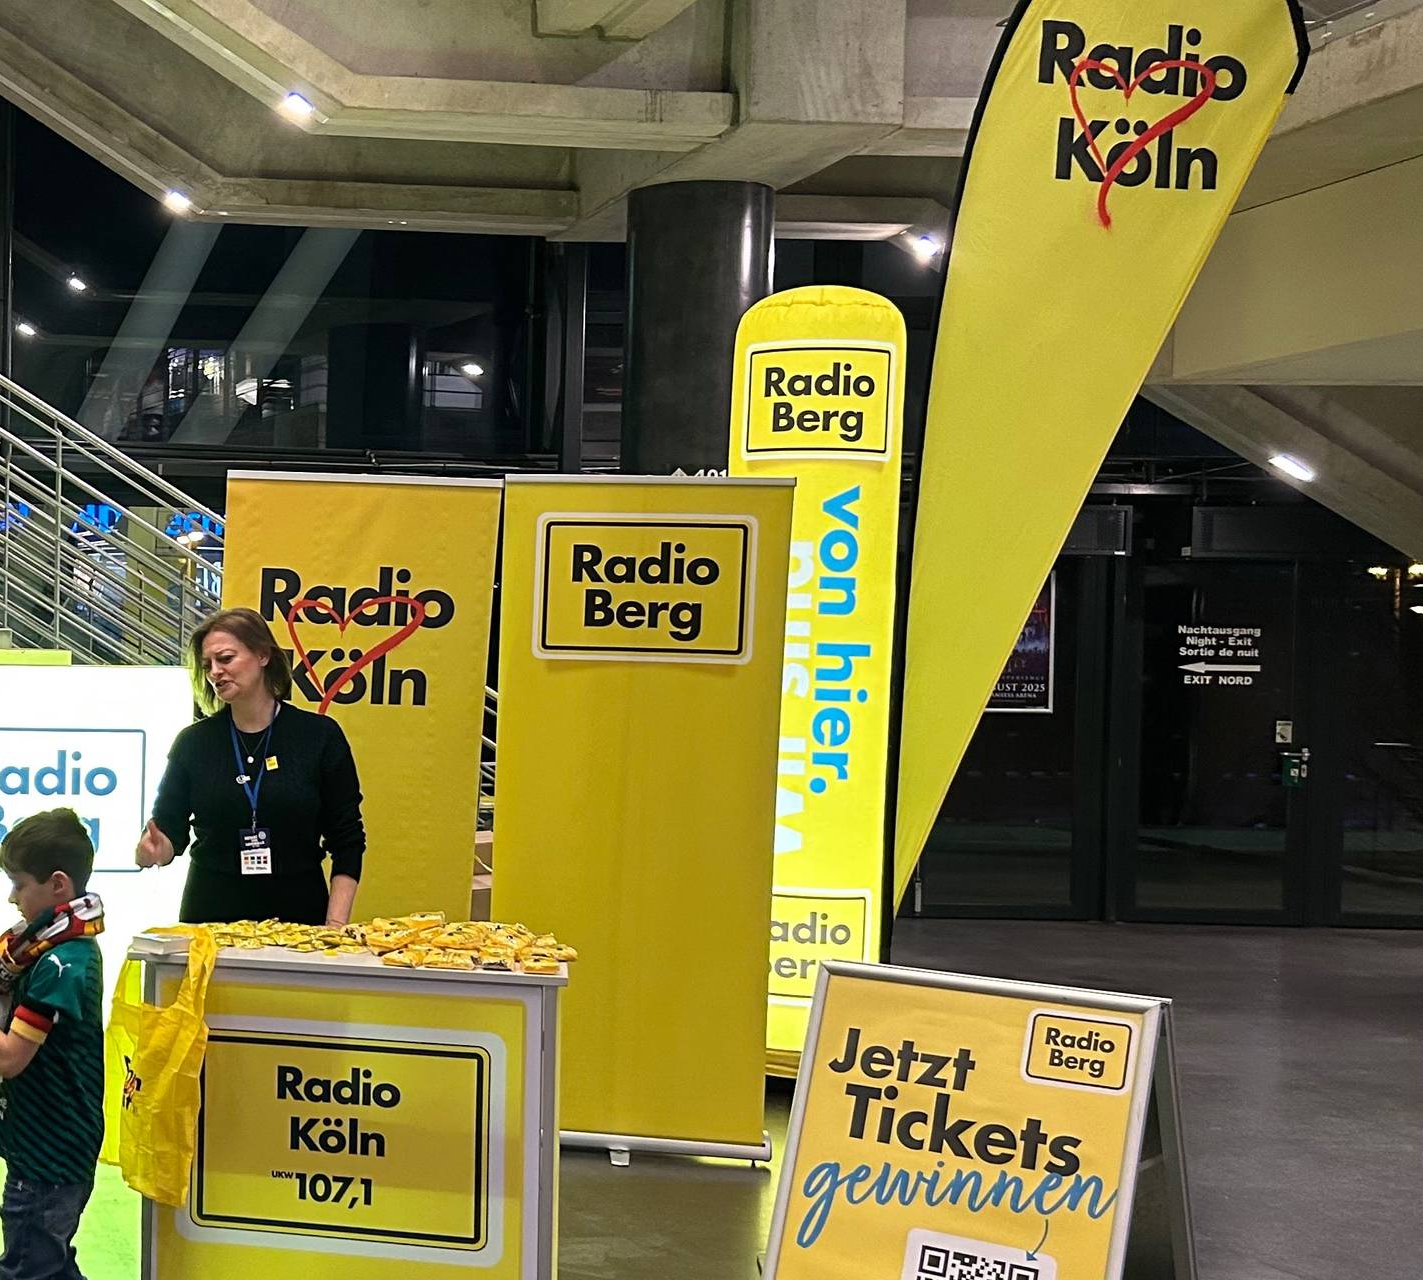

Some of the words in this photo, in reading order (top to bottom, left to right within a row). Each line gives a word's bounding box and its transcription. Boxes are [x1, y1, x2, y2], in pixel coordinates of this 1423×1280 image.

[1038, 19, 1248, 101] Radio
[1055, 117, 1218, 190] Köln
[764, 362, 875, 398] Radio
[772, 402, 864, 442] Berg
[571, 541, 720, 585] Radio
[818, 485, 861, 616] von
[260, 567, 455, 629] Radio
[583, 588, 703, 642] Berg
[1177, 625, 1261, 637] Nachtausgang
[1179, 647, 1215, 656] Sortie
[1219, 647, 1233, 657] de
[1237, 648, 1259, 657] nuit
[1186, 636, 1217, 647] Night
[1228, 637, 1252, 646] Exit
[281, 648, 427, 706] Köln
[1021, 683, 1045, 692] 2025
[1183, 675, 1212, 684] EXIT
[1218, 676, 1253, 685] NORD
[809, 643, 871, 794] hier.
[770, 911, 851, 945] adio
[828, 1028, 976, 1091] Jetzt
[1045, 1027, 1116, 1054] Radio
[1049, 1049, 1106, 1078] Berg
[277, 1065, 401, 1108] Radio
[289, 1116, 385, 1157] Köln
[844, 1083, 1082, 1177] Tickets
[271, 1170, 294, 1180] UKW
[295, 1172, 372, 1209] 107,1
[796, 1161, 1119, 1249] gewinnen
